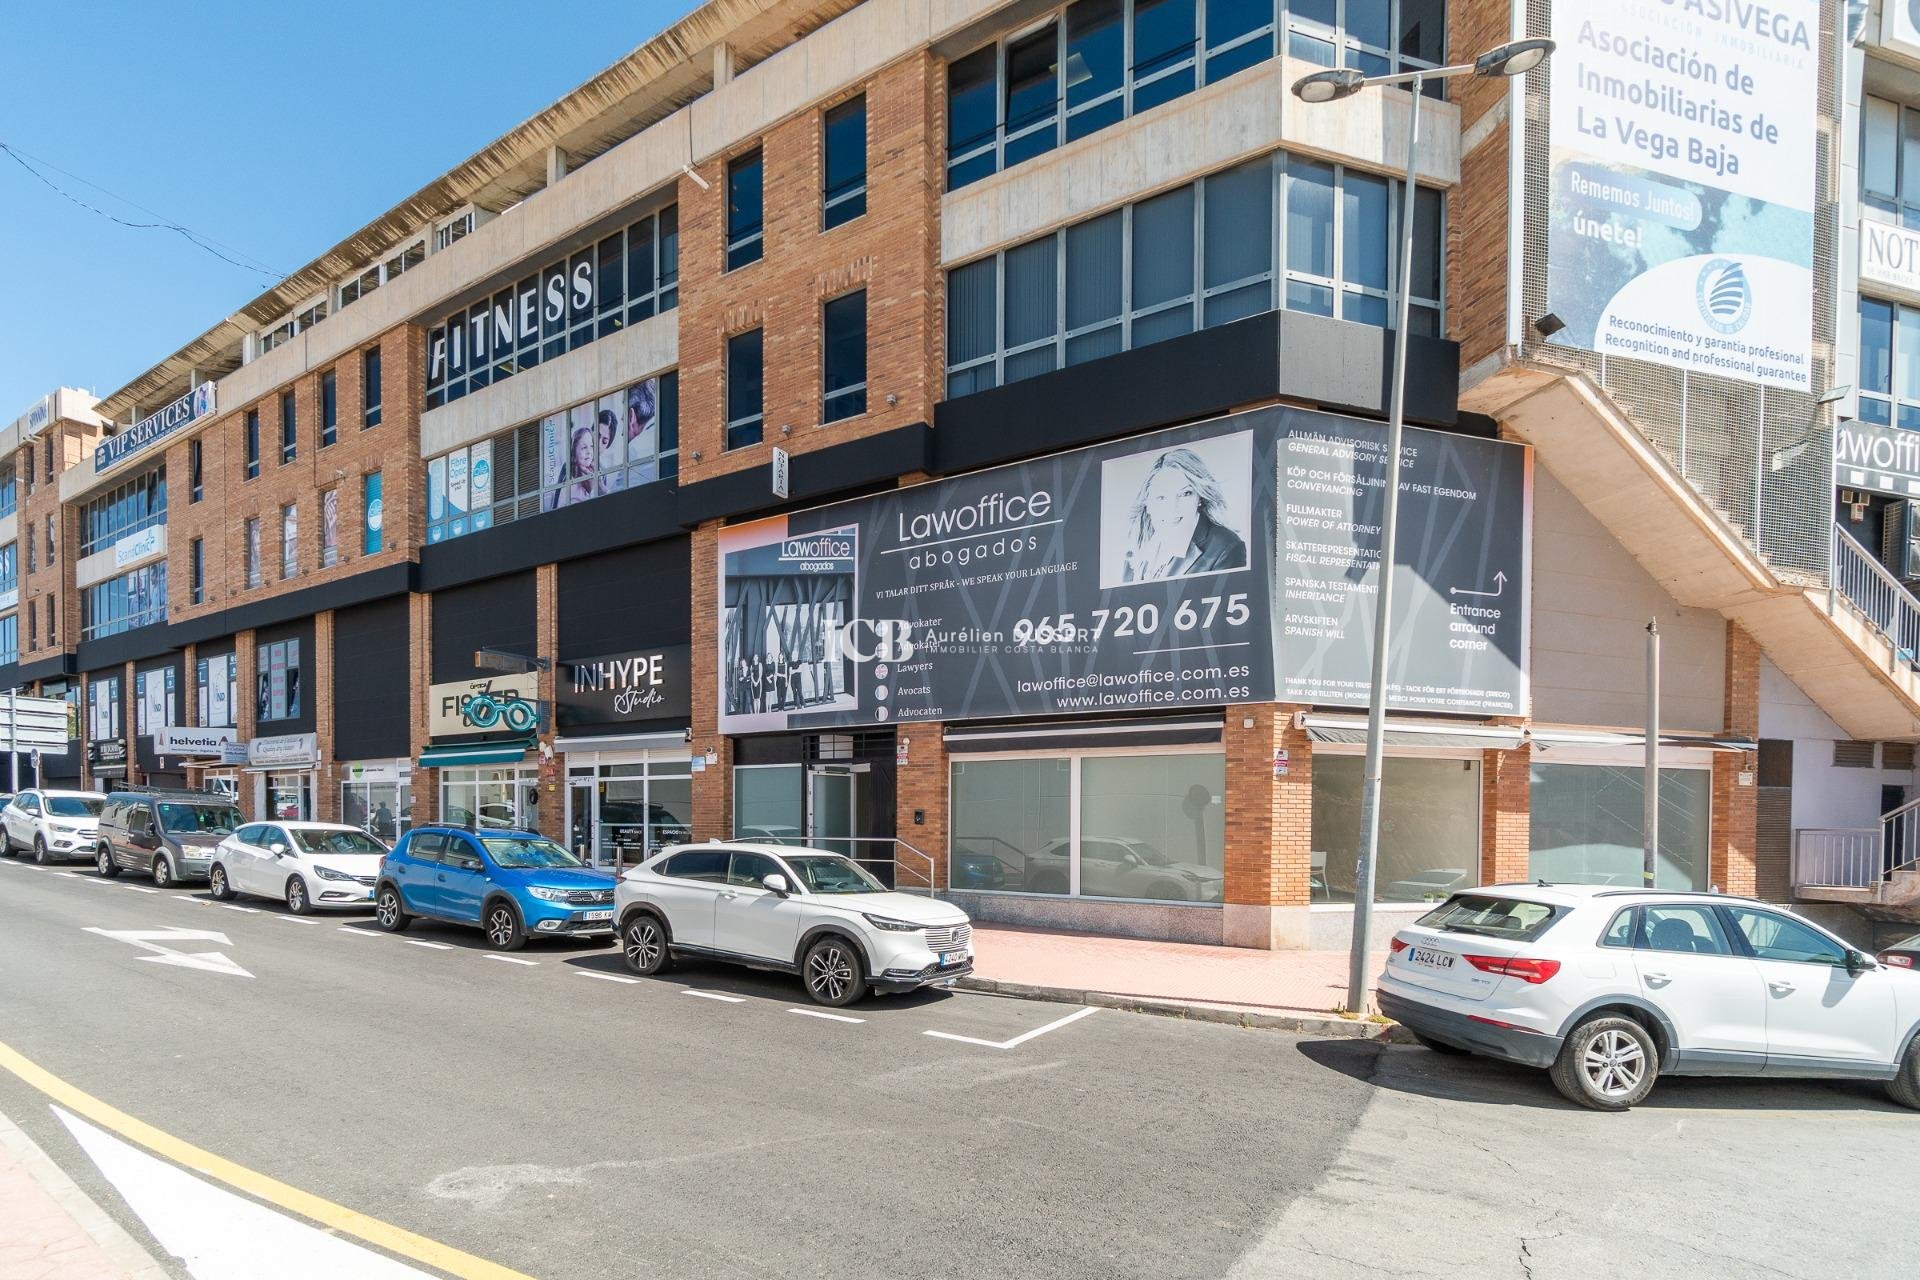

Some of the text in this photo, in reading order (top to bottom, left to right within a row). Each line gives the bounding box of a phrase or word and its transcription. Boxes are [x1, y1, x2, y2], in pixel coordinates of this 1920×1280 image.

[1578, 19, 1754, 95] Asociación de
[1578, 62, 1778, 144] Inmobiliarias de
[1577, 105, 1739, 176] La Vega Baja
[1571, 171, 1640, 208] Rememos
[1573, 210, 1643, 248] únete!
[1867, 227, 1920, 275] NOT
[431, 262, 592, 380] FITNESS
[1610, 315, 1693, 344] Reconocimiento
[1696, 336, 1702, 346] y
[1748, 345, 1804, 365] profesional
[1605, 333, 1807, 383] Recognition and professional guarantee
[108, 434, 128, 459] VIP
[130, 396, 191, 448] SERVICES
[1288, 429, 1326, 442] ALLMÄN
[1328, 436, 1380, 452] ADVISORISK
[1288, 442, 1330, 457] GENERAL
[1331, 448, 1377, 463] ADVISORY
[1287, 466, 1306, 477] KÖP
[1309, 470, 1331, 480] OCH
[1399, 483, 1410, 491] AV
[1412, 484, 1432, 495] FAST
[1434, 487, 1477, 500] EGENDOM
[1287, 480, 1364, 497] CONVEYANCING
[899, 491, 1051, 542] Lawoffice
[1286, 503, 1343, 518] FULLMAKTER
[1286, 516, 1382, 535] POWER OF ATTORNEY
[782, 538, 850, 557] Lawoffice
[909, 536, 1037, 569] abogados
[1286, 553, 1317, 564] FISCAL
[800, 561, 834, 573] abogados
[885, 587, 909, 598] TALAR
[910, 584, 929, 594] DITT
[930, 579, 955, 592] SPRÅK
[961, 577, 975, 587] WE
[976, 573, 1004, 585] SPEAK
[1005, 569, 1028, 581] YOUR
[1029, 561, 1078, 576] LANGUAGE
[1285, 577, 1379, 594] SPANSKA TESTAMENT
[1285, 590, 1345, 603] INHERITANCE
[1013, 593, 1250, 647] 965 720 675
[1285, 614, 1338, 626] ARVSKIFTEN
[1450, 603, 1501, 618] Entrance
[1285, 626, 1345, 639] SPANISH WILL
[1449, 622, 1496, 635] arround
[1449, 638, 1488, 650] corner
[575, 654, 663, 694] INHYPE
[897, 661, 933, 674] Lawyers
[1018, 664, 1250, 693] lawoffice@lawoffice.com.es
[897, 685, 931, 696] Avocats
[1056, 684, 1250, 708] www.lawoffice.com.es
[1354, 681, 1372, 689] TRUS
[614, 685, 665, 714] Studio
[897, 706, 943, 718] Advocaten
[170, 737, 216, 746] helvetia
